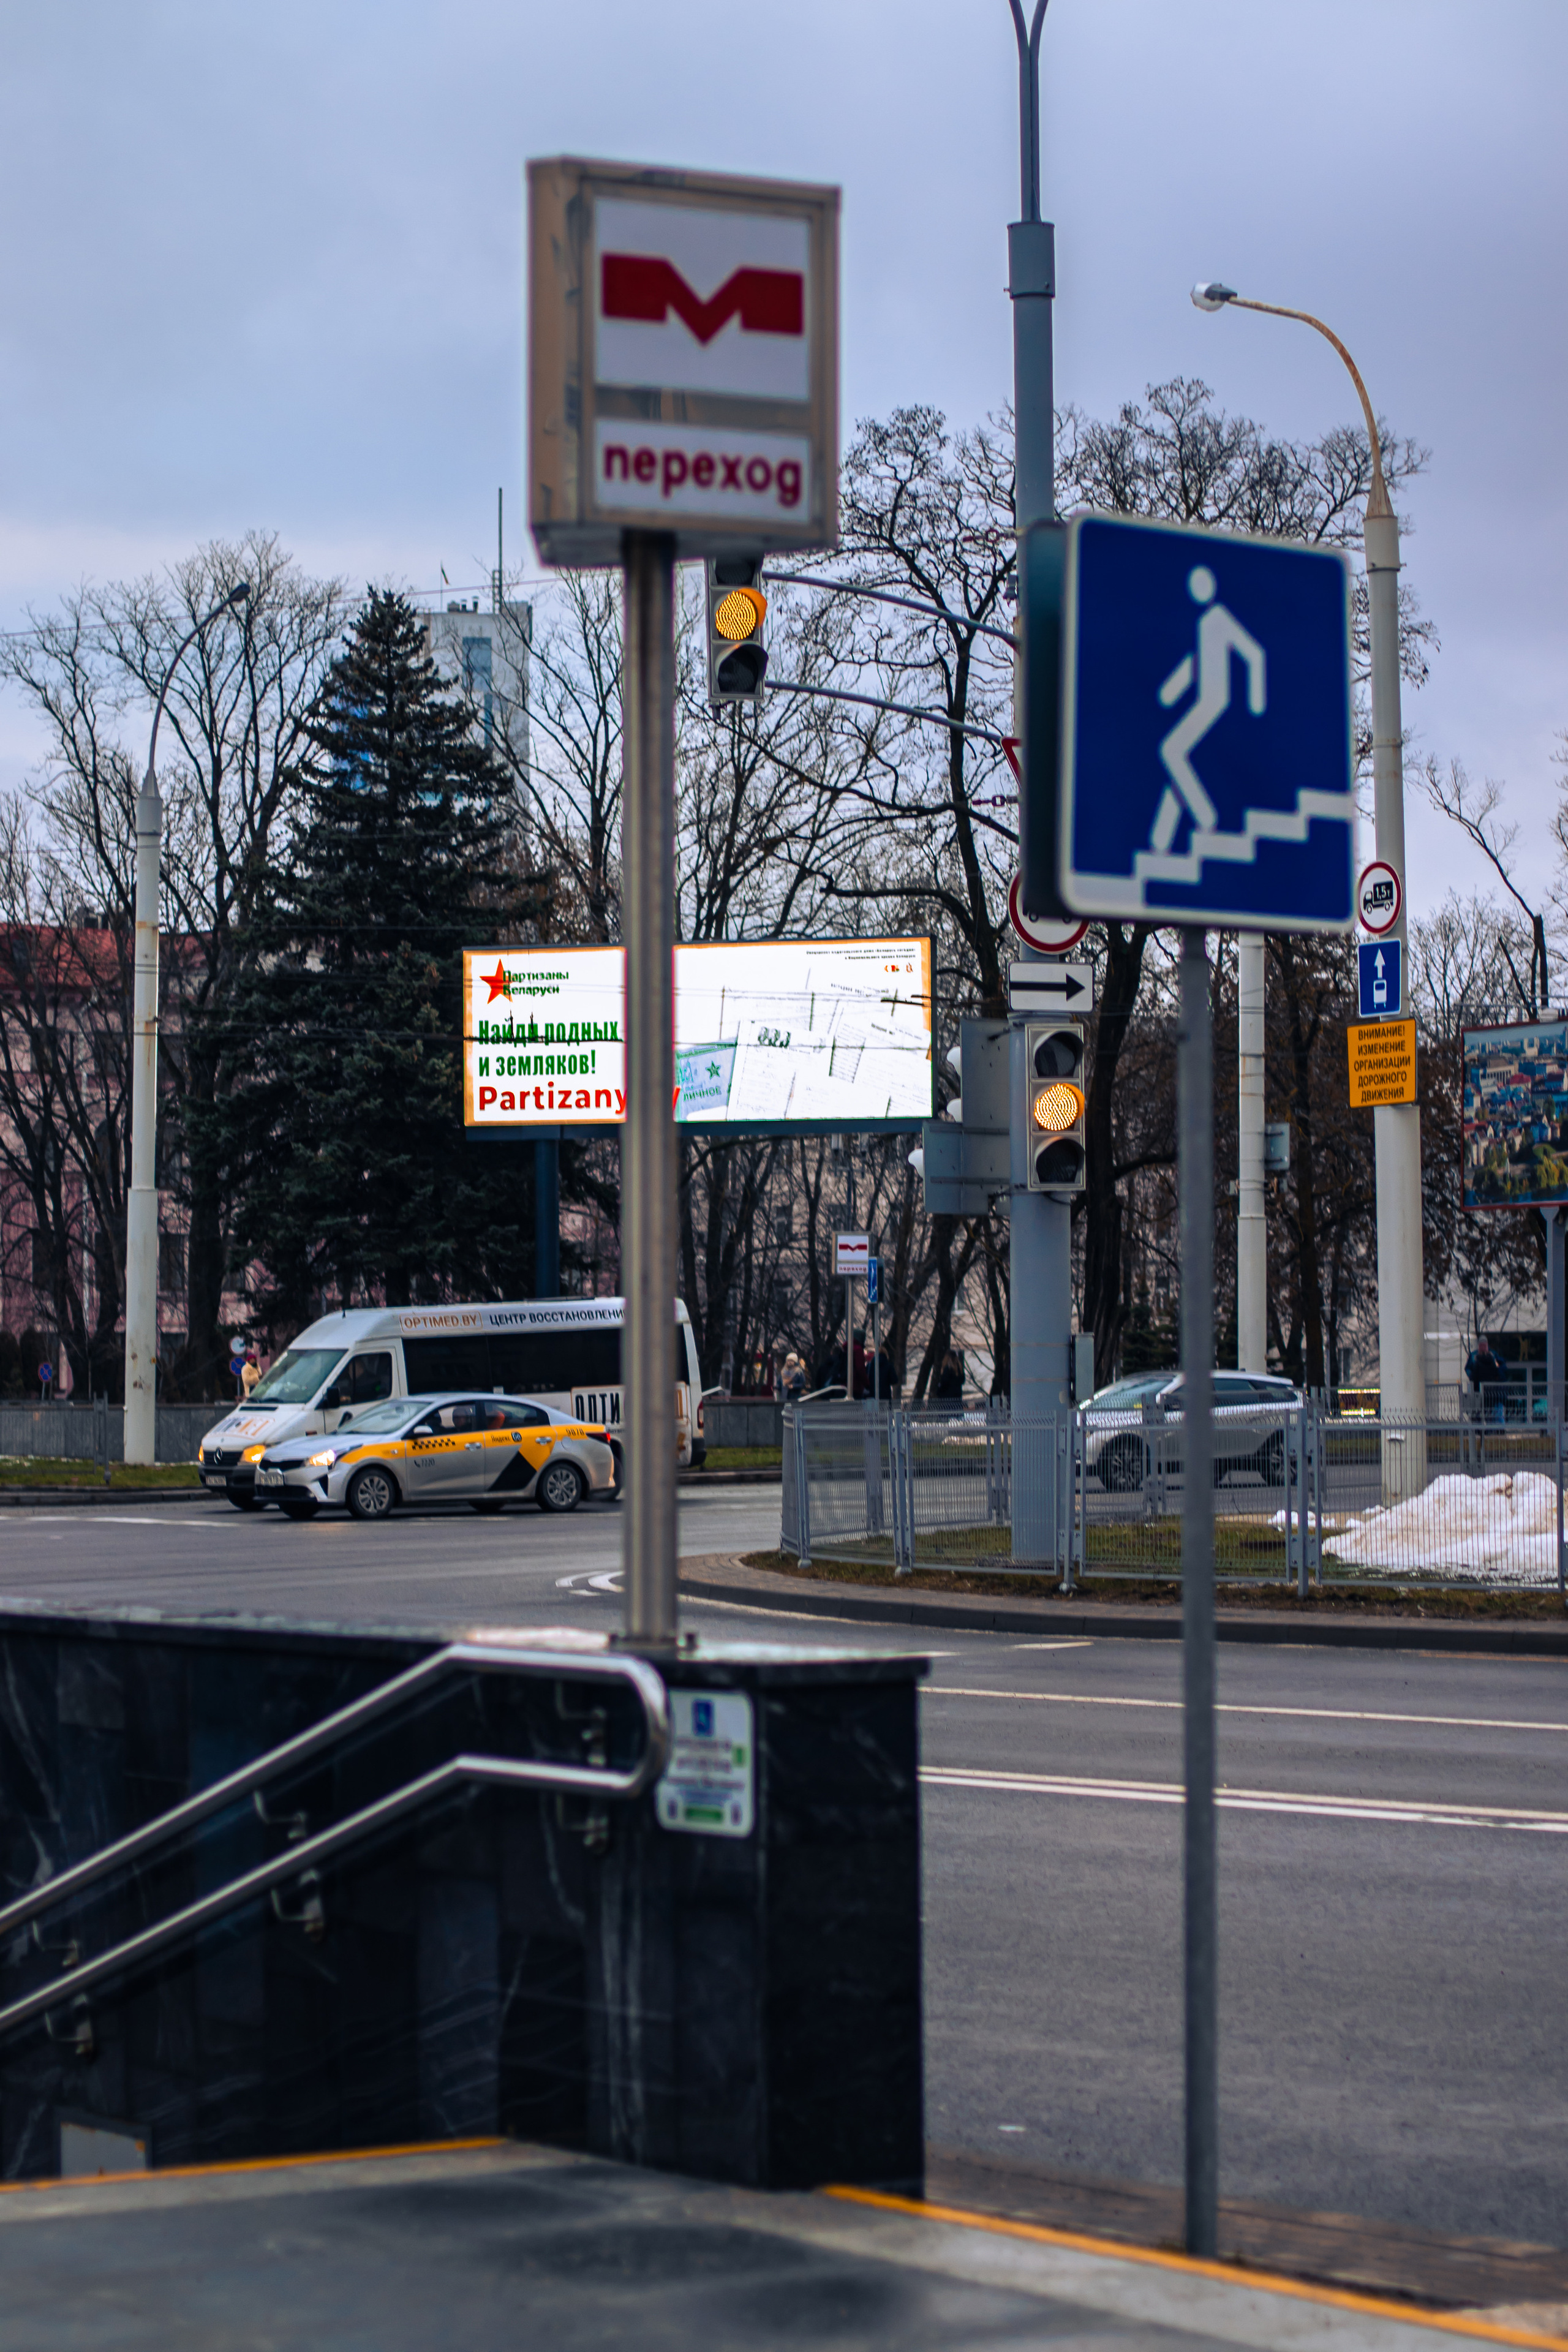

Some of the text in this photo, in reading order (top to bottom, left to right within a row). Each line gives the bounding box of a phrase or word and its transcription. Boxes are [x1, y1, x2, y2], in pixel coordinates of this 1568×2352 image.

[503, 970, 569, 983] Партизаны
[503, 984, 560, 997] Беларуси
[479, 1017, 618, 1048] Найди родных
[1358, 1025, 1405, 1041] ВНИМАНИЕ!
[1358, 1040, 1406, 1056] ИЗМЕНЕНИЕ
[479, 1049, 596, 1077] и земляков!
[1354, 1055, 1411, 1072] ОРГАНИЗАЦИИ
[1358, 1071, 1407, 1089] ДОРОЖНОГО
[479, 1081, 680, 1115] Partizany
[1361, 1087, 1404, 1104] ДВИЖЕНИЯ
[404, 1314, 477, 1329] OPTIMED.BY
[489, 1308, 624, 1328] ЦЕНТР ВОССТАНОВЛЕНИ
